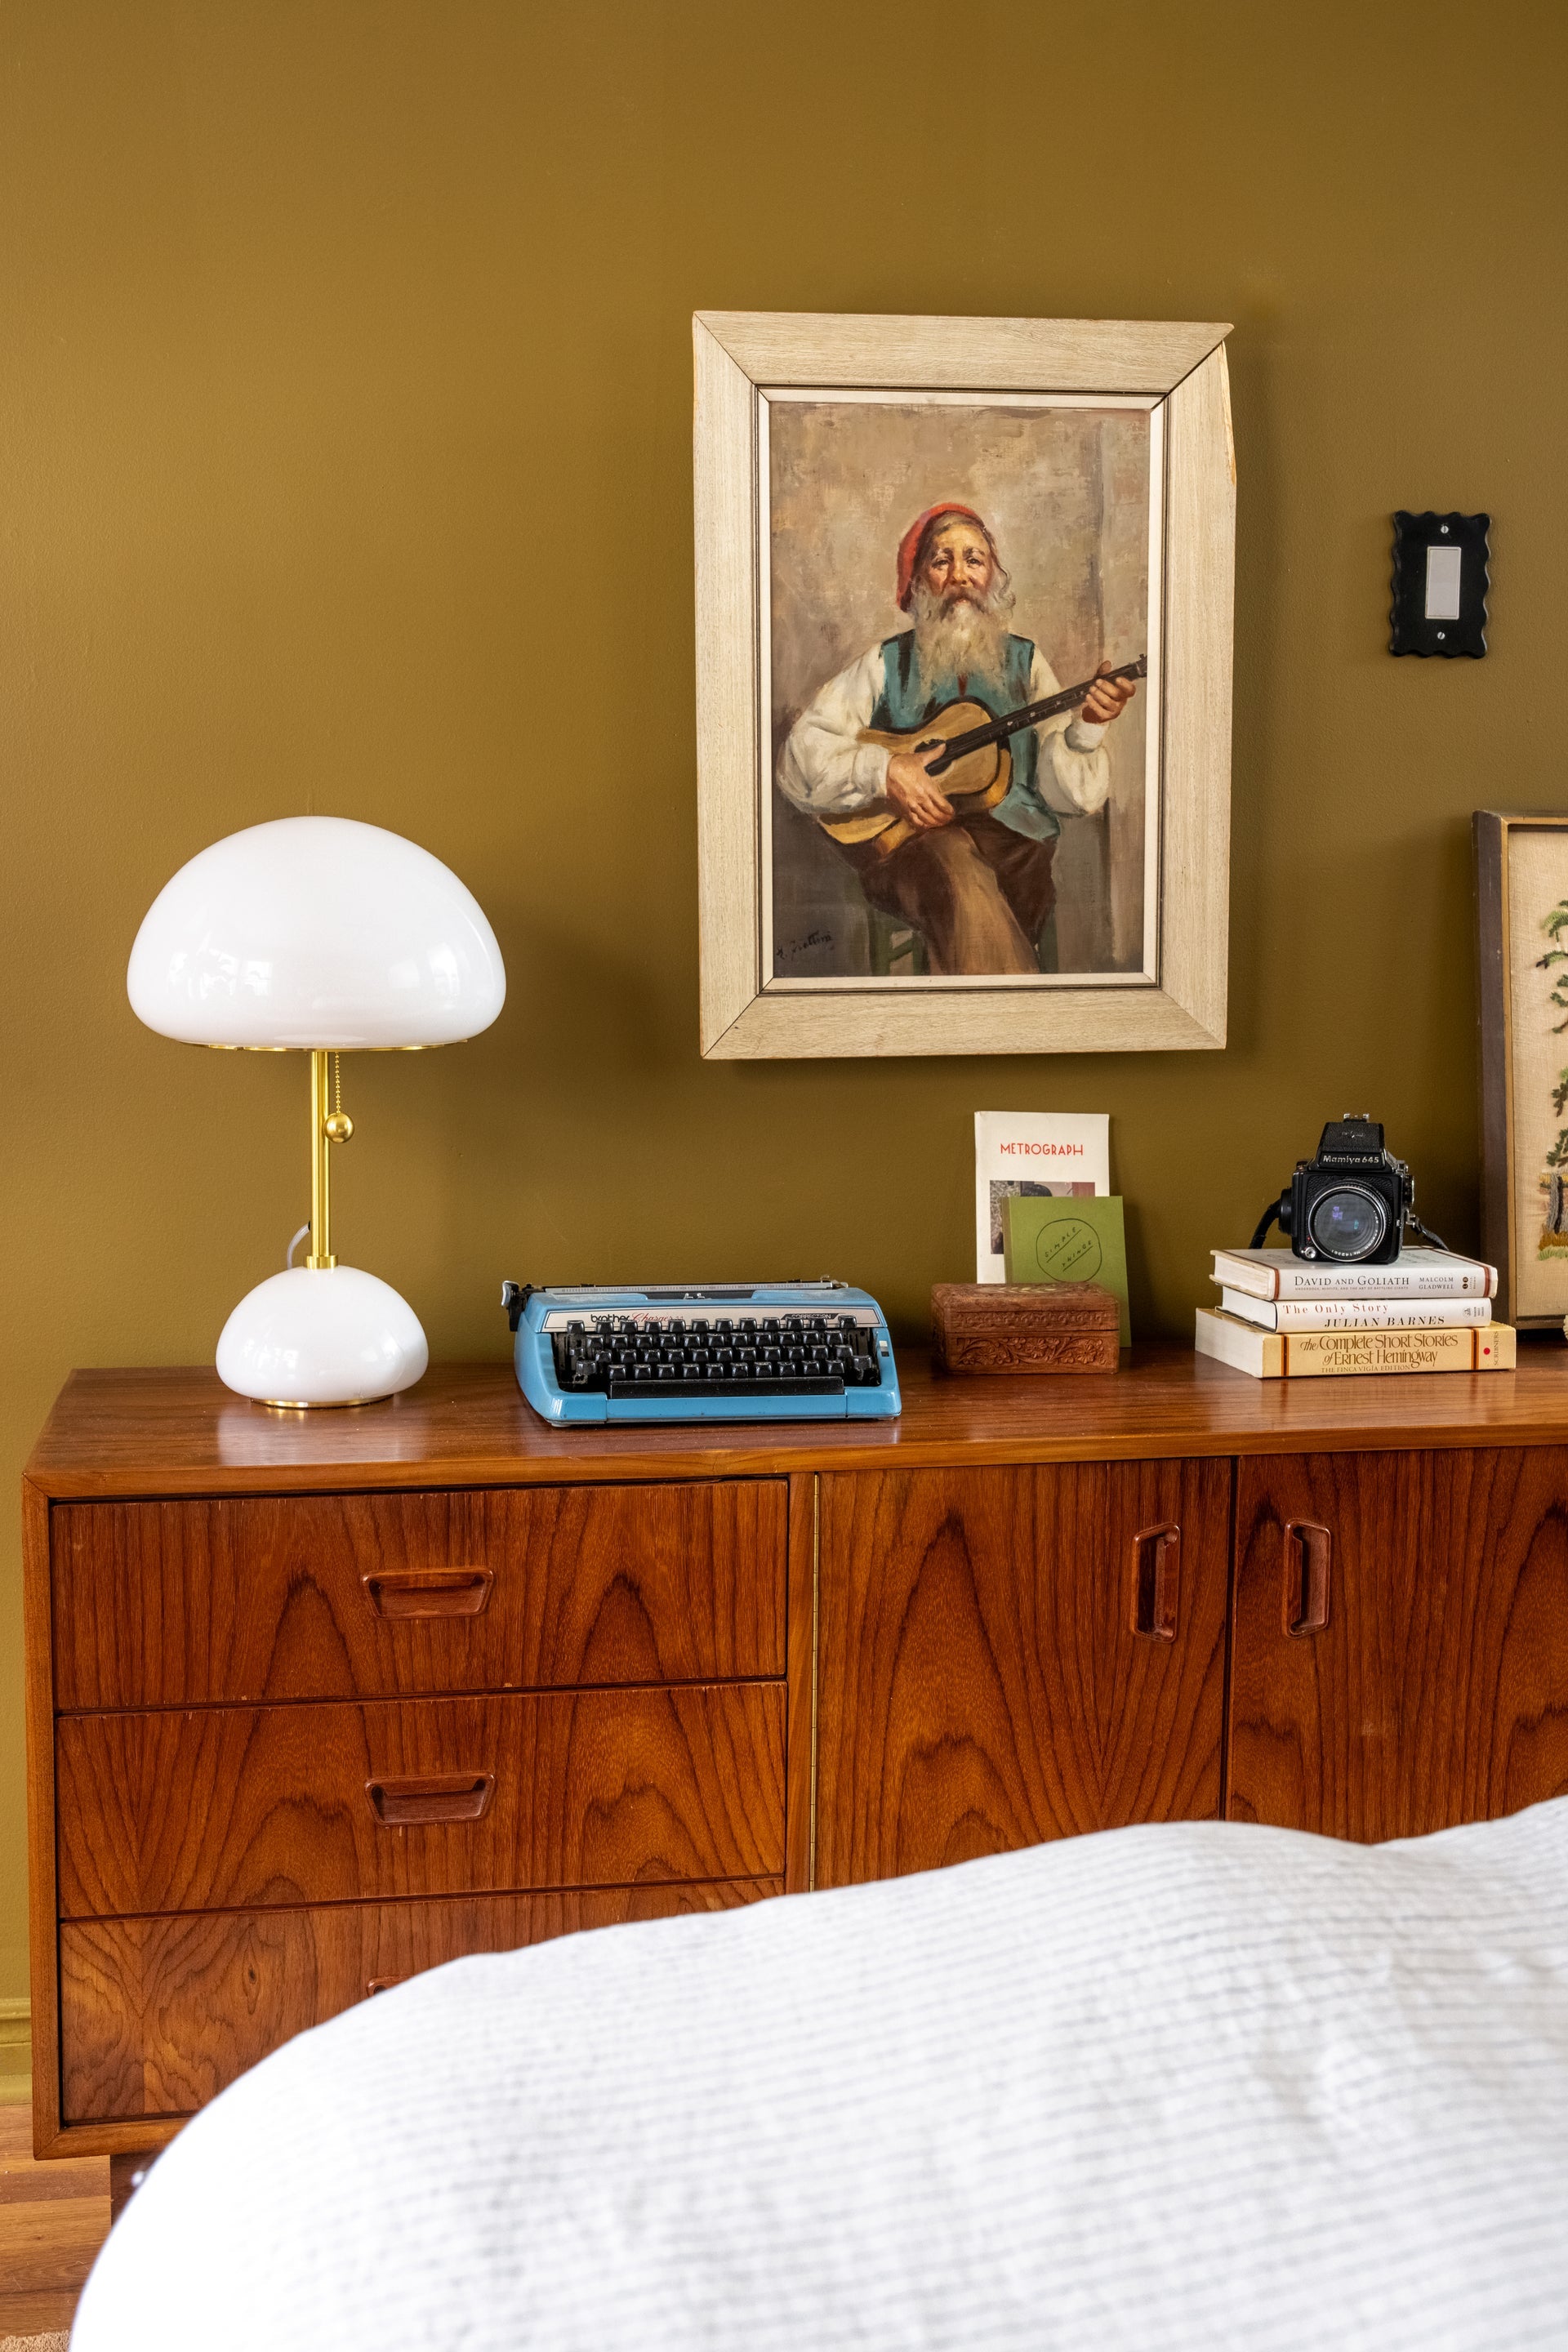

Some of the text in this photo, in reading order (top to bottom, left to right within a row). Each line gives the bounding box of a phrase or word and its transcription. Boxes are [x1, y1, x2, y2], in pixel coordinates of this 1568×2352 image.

[1000, 1143, 1084, 1156] METROGRAPH
[1323, 1155, 1379, 1165] Mamiya 645
[1045, 1227, 1076, 1258] SIMPLE
[1294, 1276, 1332, 1286] DAVID
[1357, 1275, 1410, 1286] GOLIATH
[1283, 1303, 1388, 1315] The Only Story
[1324, 1316, 1446, 1328] JULIAN BARNES
[1300, 1333, 1459, 1352] The Complete Short Stories
[1323, 1349, 1437, 1369] of Ernest Hemingway
